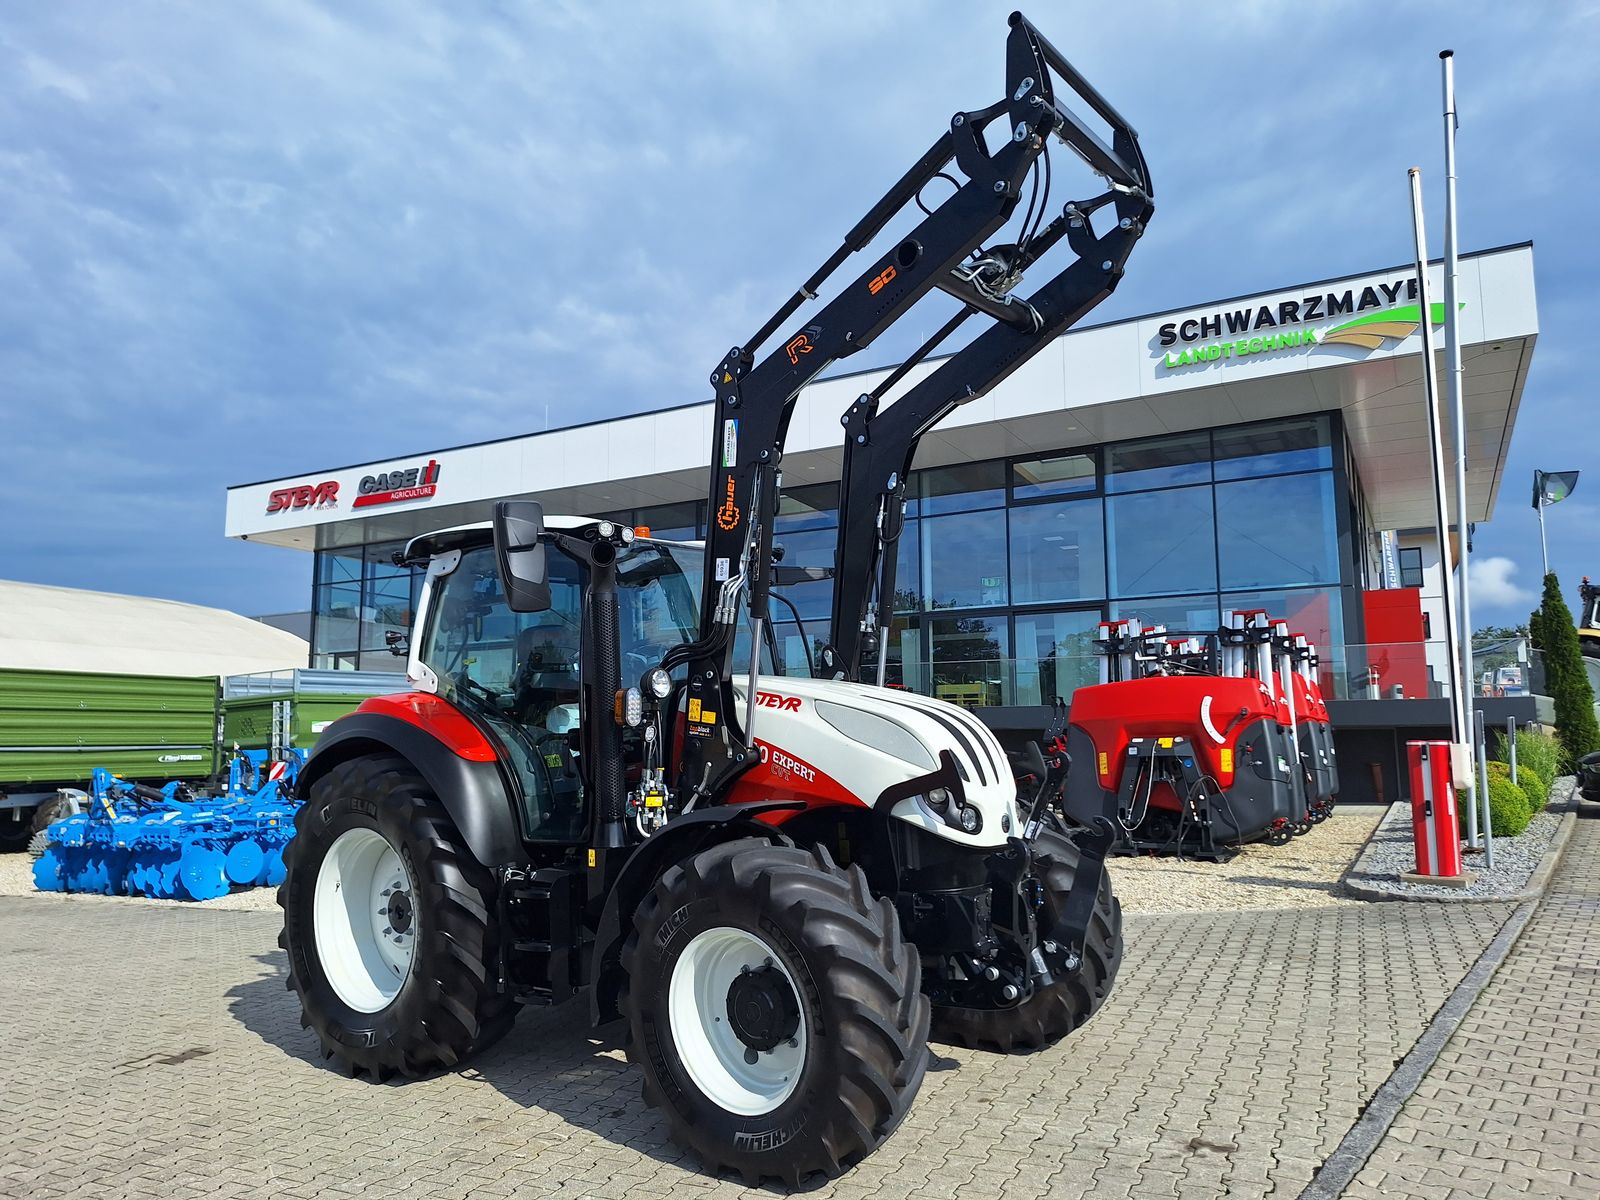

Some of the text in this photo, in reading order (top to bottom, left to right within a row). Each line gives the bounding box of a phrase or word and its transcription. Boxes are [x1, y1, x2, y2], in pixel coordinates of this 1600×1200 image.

[786, 334, 814, 365] R
[1165, 327, 1318, 368] LANDTECHNIK
[266, 481, 340, 511] STEYR
[359, 468, 419, 494] CASE
[391, 487, 432, 499] AGRICULTURE
[722, 474, 736, 522] hauer
[770, 763, 791, 782] CVT
[772, 750, 816, 783] EXPERT
